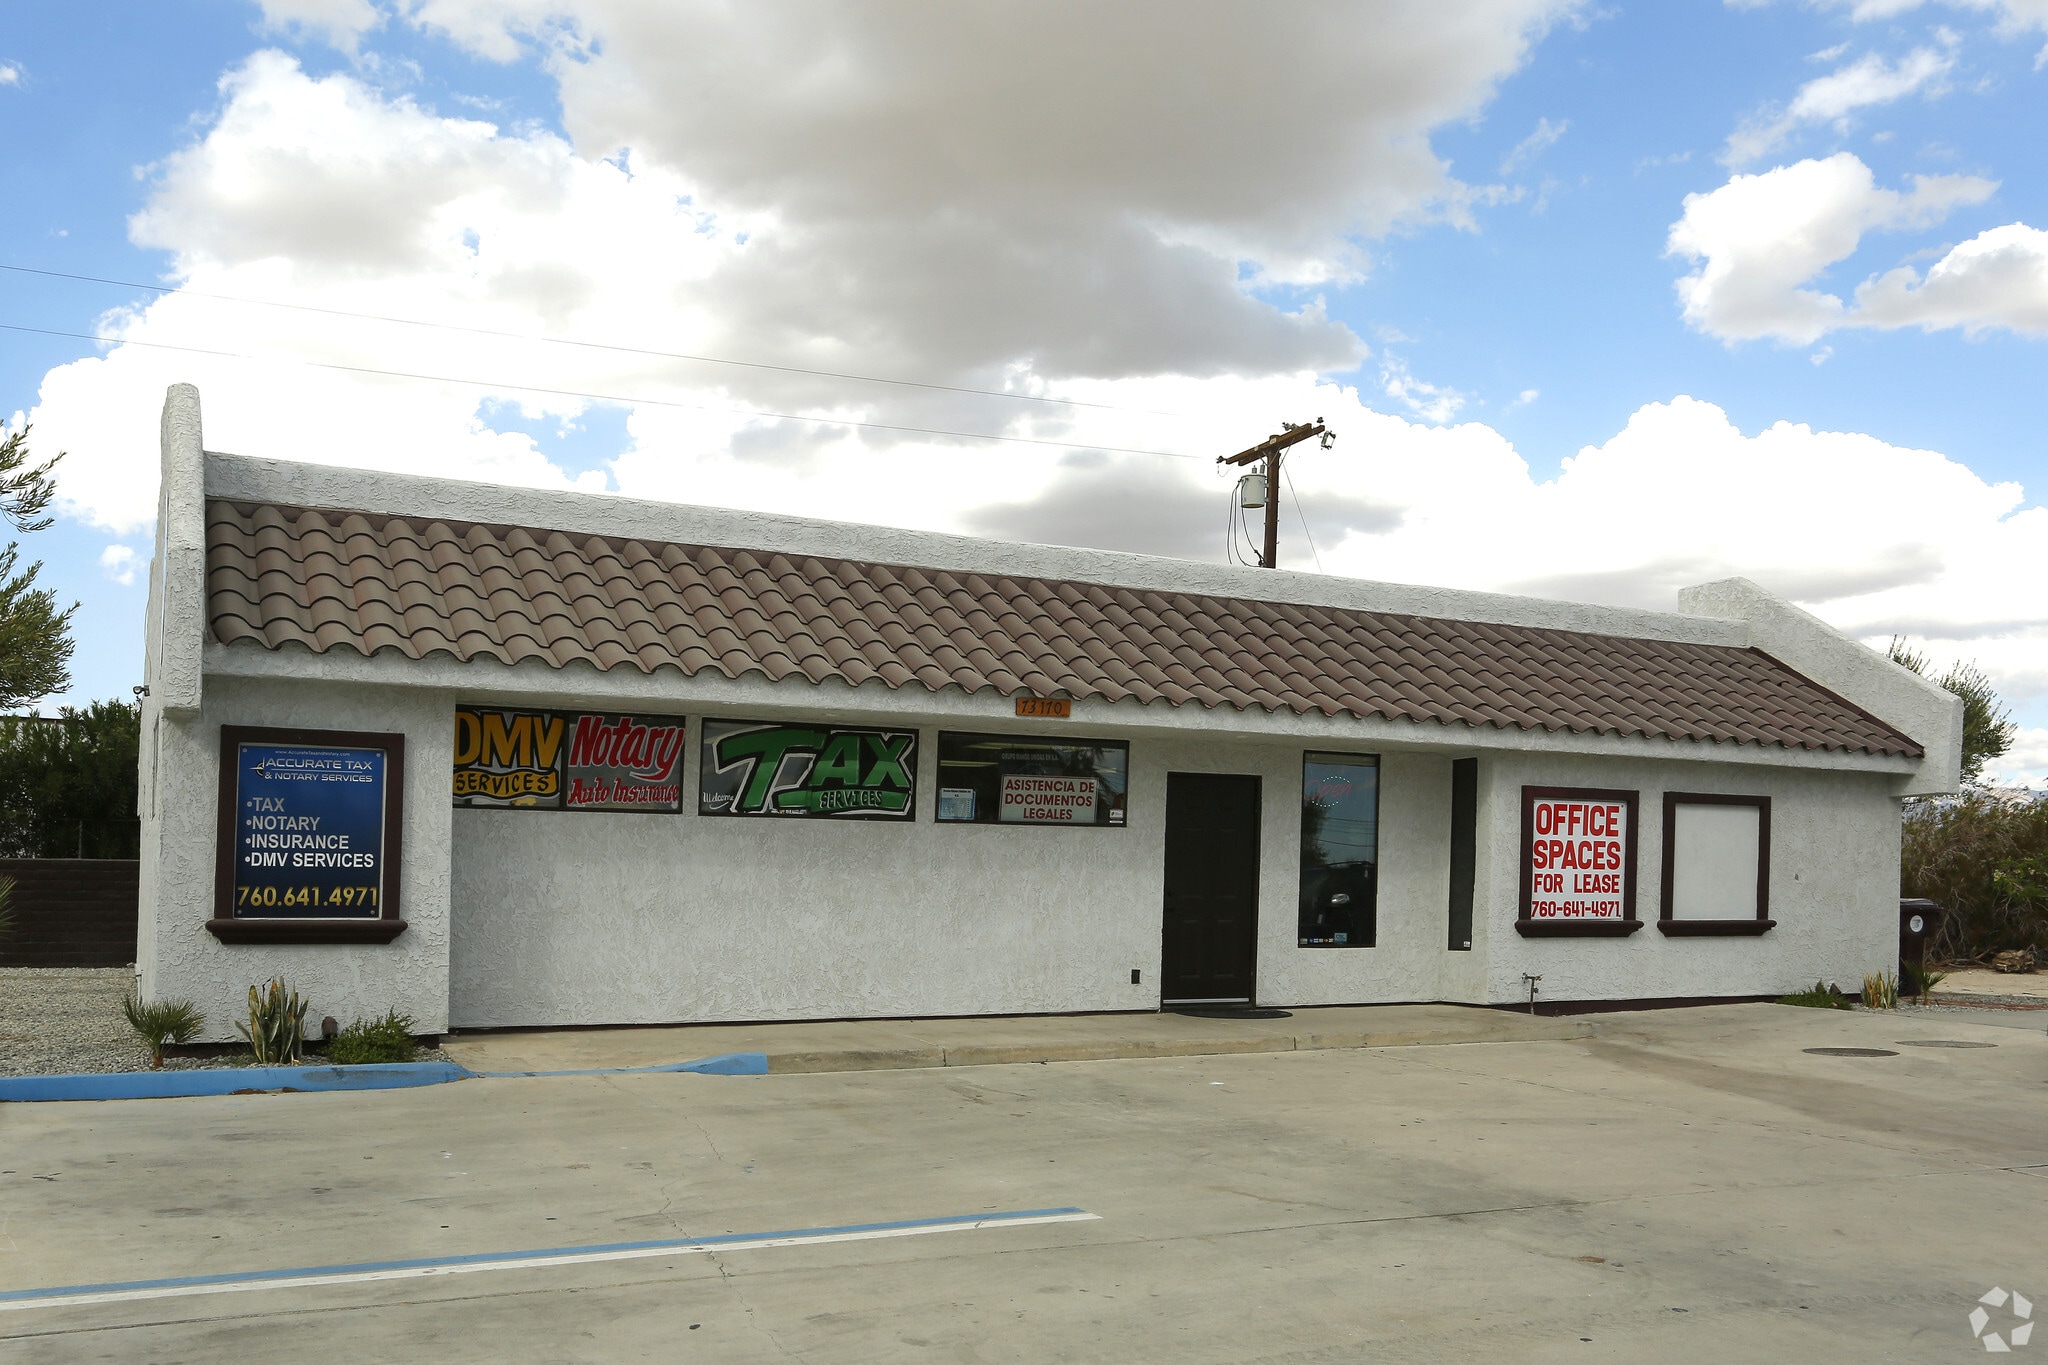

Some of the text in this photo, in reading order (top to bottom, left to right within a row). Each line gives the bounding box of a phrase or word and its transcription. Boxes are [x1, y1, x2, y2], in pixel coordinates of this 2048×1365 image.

[453, 712, 565, 768] DMV
[568, 715, 686, 782] Notary
[265, 758, 373, 770] ACCURATE TAX
[716, 727, 912, 811] TAX
[264, 771, 373, 783] & NOTARY SERVICES
[455, 773, 550, 795] SERVICES
[1005, 779, 1095, 793] ASISTENCIA DE
[567, 777, 611, 805] Auto
[612, 777, 680, 804] Insurance
[703, 791, 734, 803] Welcome
[819, 789, 883, 809] SERVICES
[1005, 793, 1093, 807] DOCUMENTOS
[253, 797, 285, 812] TAX
[1023, 808, 1073, 820] LEGALES
[252, 816, 320, 831] NOTARY
[1535, 803, 1619, 837] OFFICE
[251, 834, 350, 850] INSURANCE
[251, 852, 375, 868] DMV SERVICES
[1533, 839, 1621, 870] SPACES
[1534, 873, 1620, 893] FOR LEASE
[237, 885, 378, 907] 760.641.4971
[1531, 900, 1620, 918] 760-641-4971
